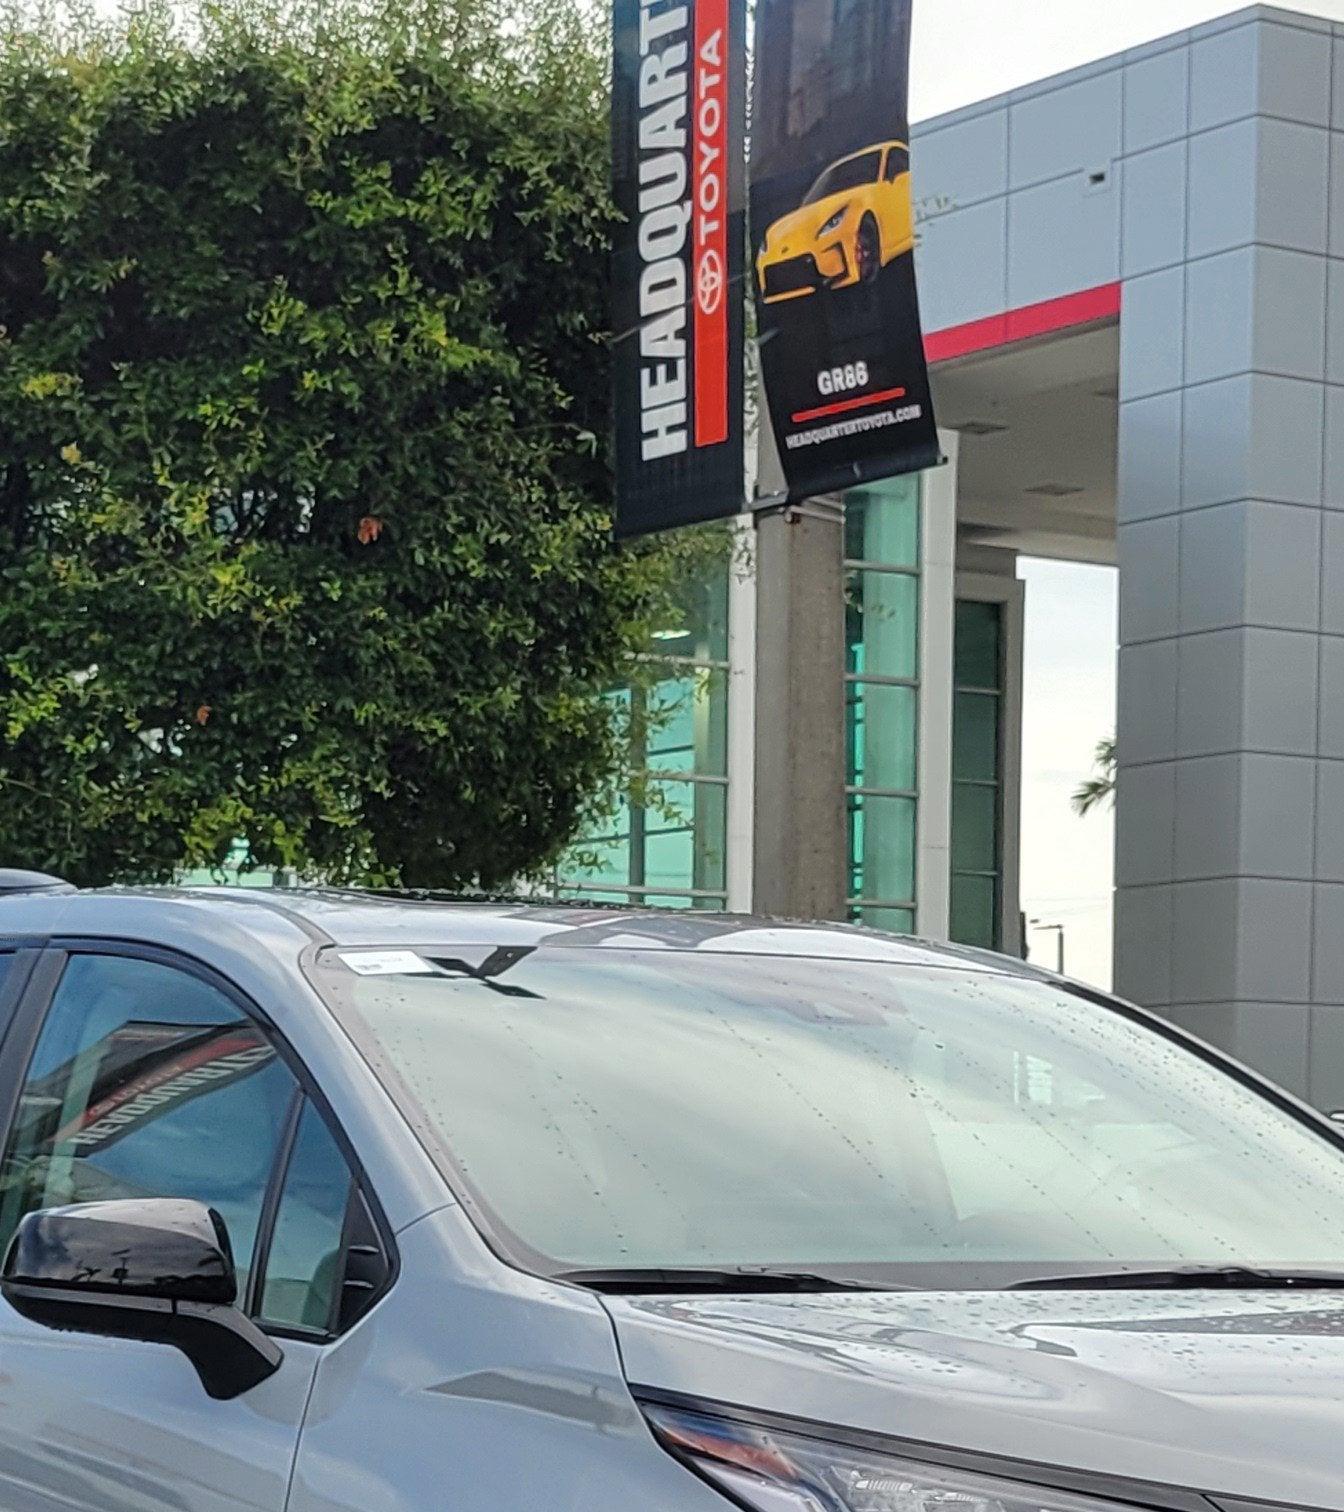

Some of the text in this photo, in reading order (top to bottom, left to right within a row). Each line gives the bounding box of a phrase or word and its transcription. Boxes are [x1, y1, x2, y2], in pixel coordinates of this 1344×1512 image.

[638, 0, 689, 462] HEADQUART
[699, 29, 722, 245] TOYOTA
[817, 360, 869, 395] GR86
